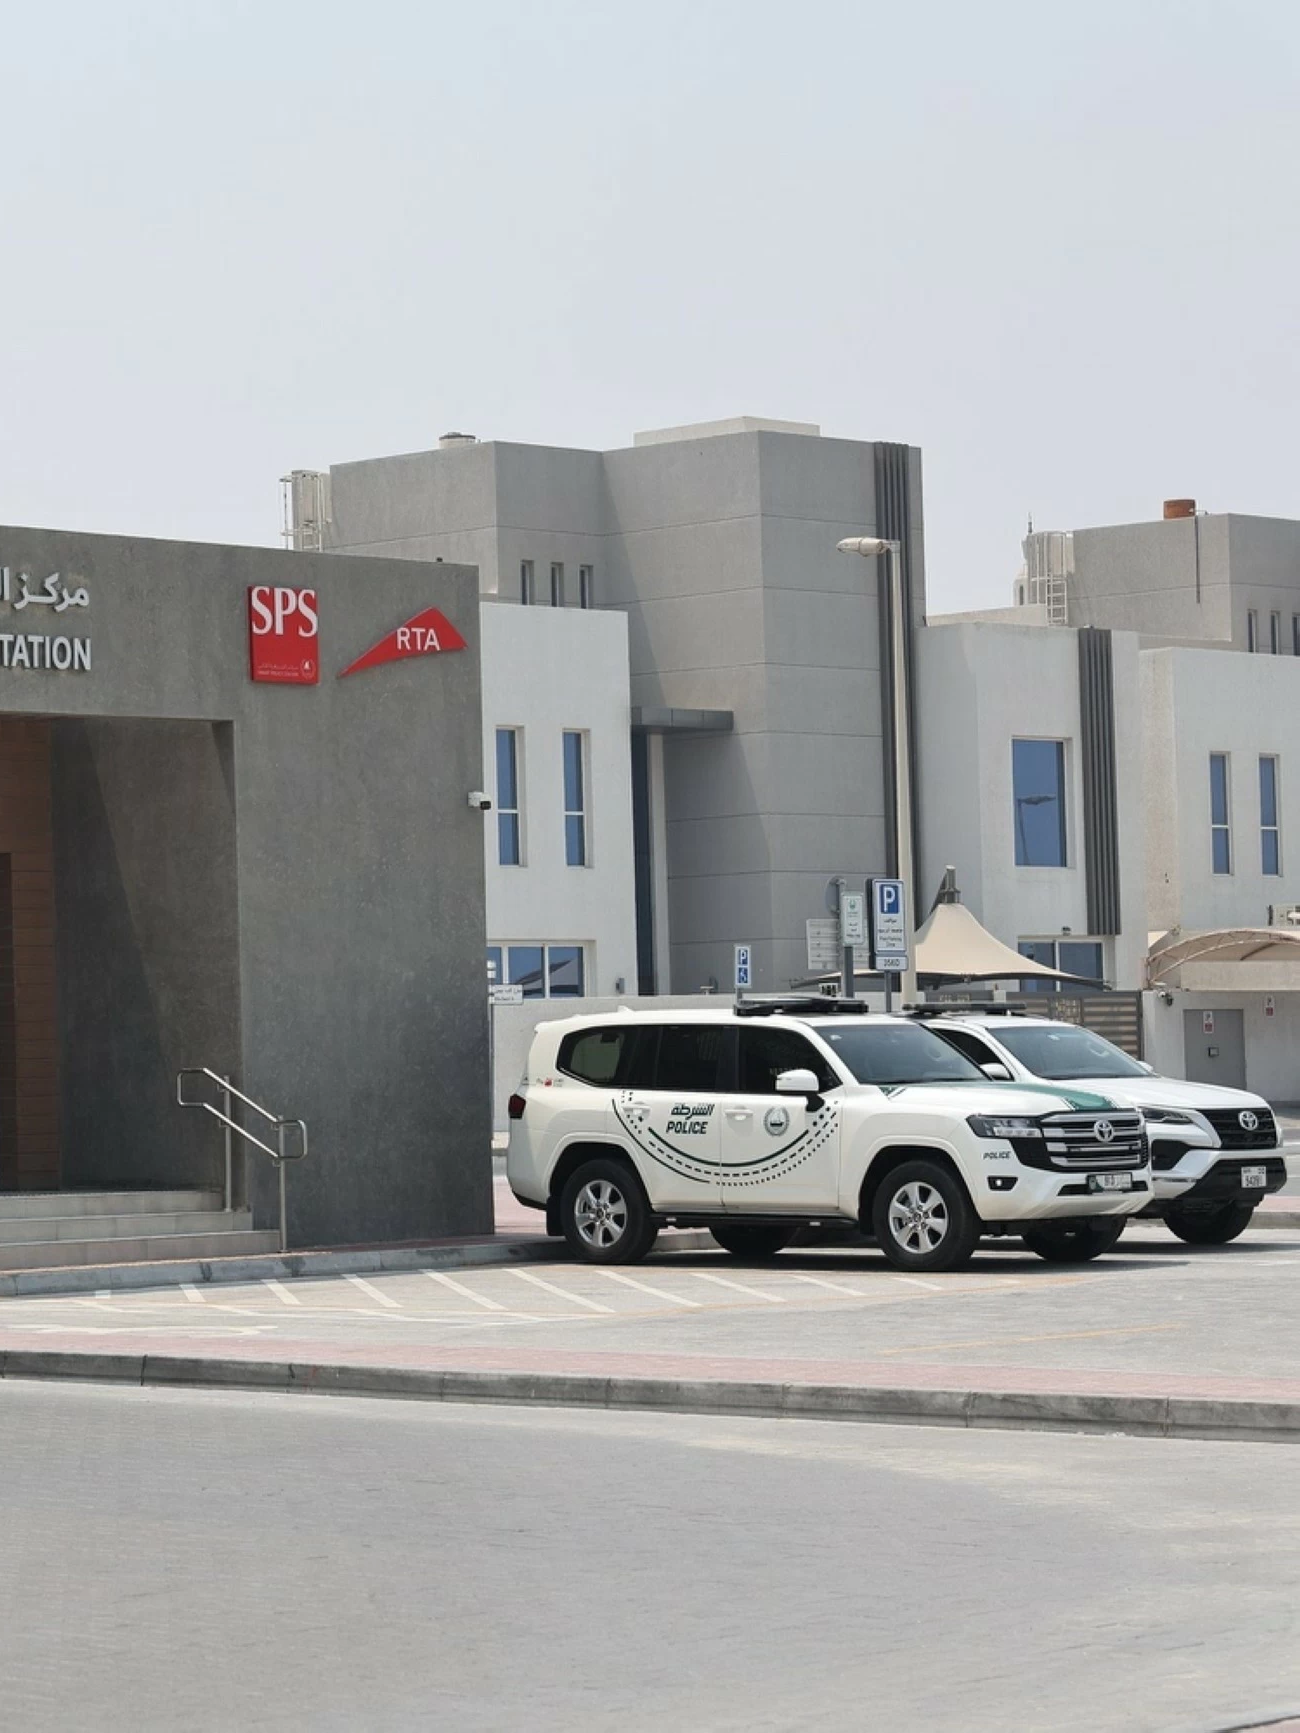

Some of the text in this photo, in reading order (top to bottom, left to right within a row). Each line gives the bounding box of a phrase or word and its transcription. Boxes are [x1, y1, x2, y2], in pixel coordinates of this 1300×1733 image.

[13, 572, 90, 612] مركز
[251, 586, 318, 637] SPS
[396, 627, 441, 651] RTA
[884, 886, 896, 912] P
[671, 1103, 715, 1120] الشرطة
[666, 1121, 708, 1135] POLICE
[983, 1151, 1011, 1160] POLICE
